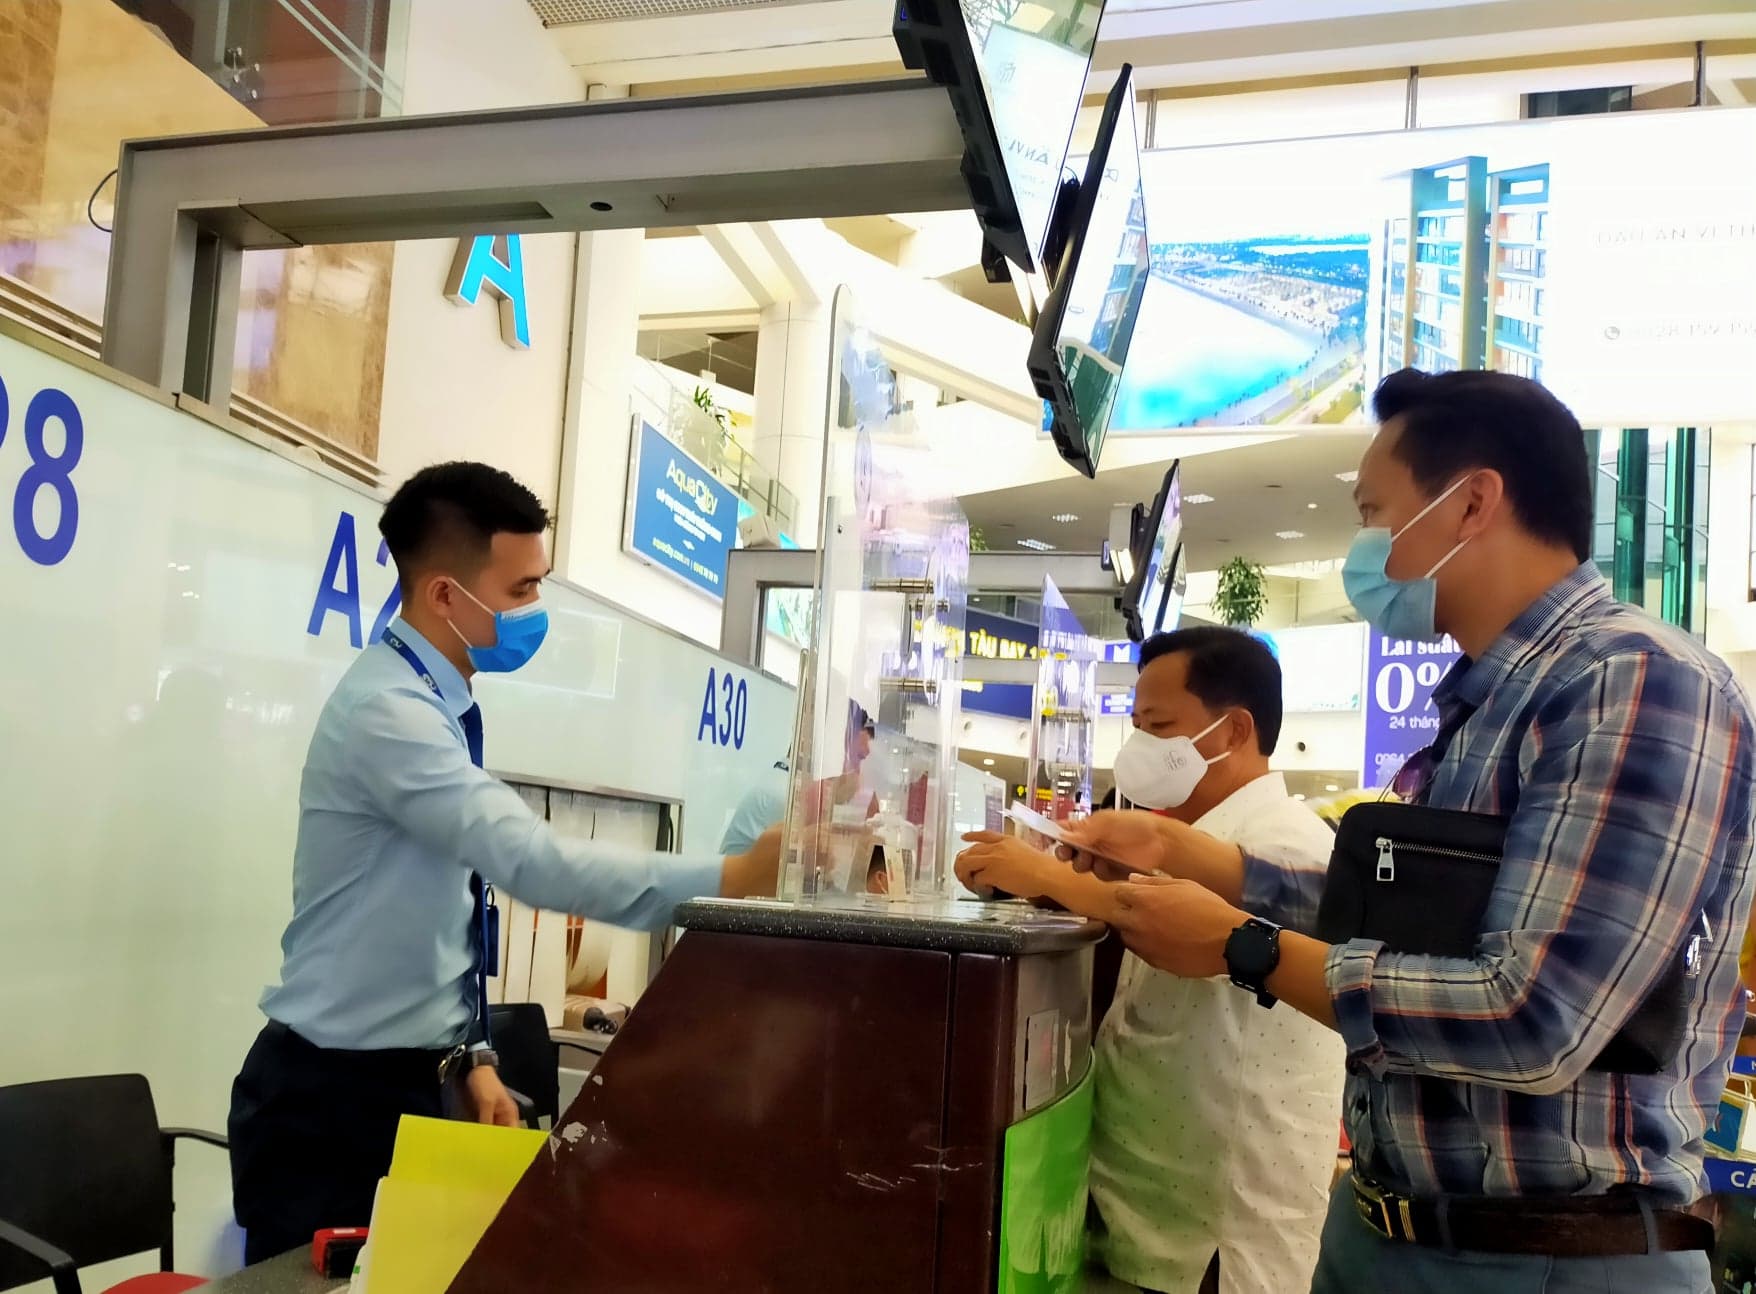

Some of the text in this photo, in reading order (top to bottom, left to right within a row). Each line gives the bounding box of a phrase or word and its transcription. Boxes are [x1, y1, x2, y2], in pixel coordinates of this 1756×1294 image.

[458, 234, 530, 349] A
[0, 375, 84, 566] 8
[698, 667, 747, 750] A30
[1389, 715, 1406, 730] 24
